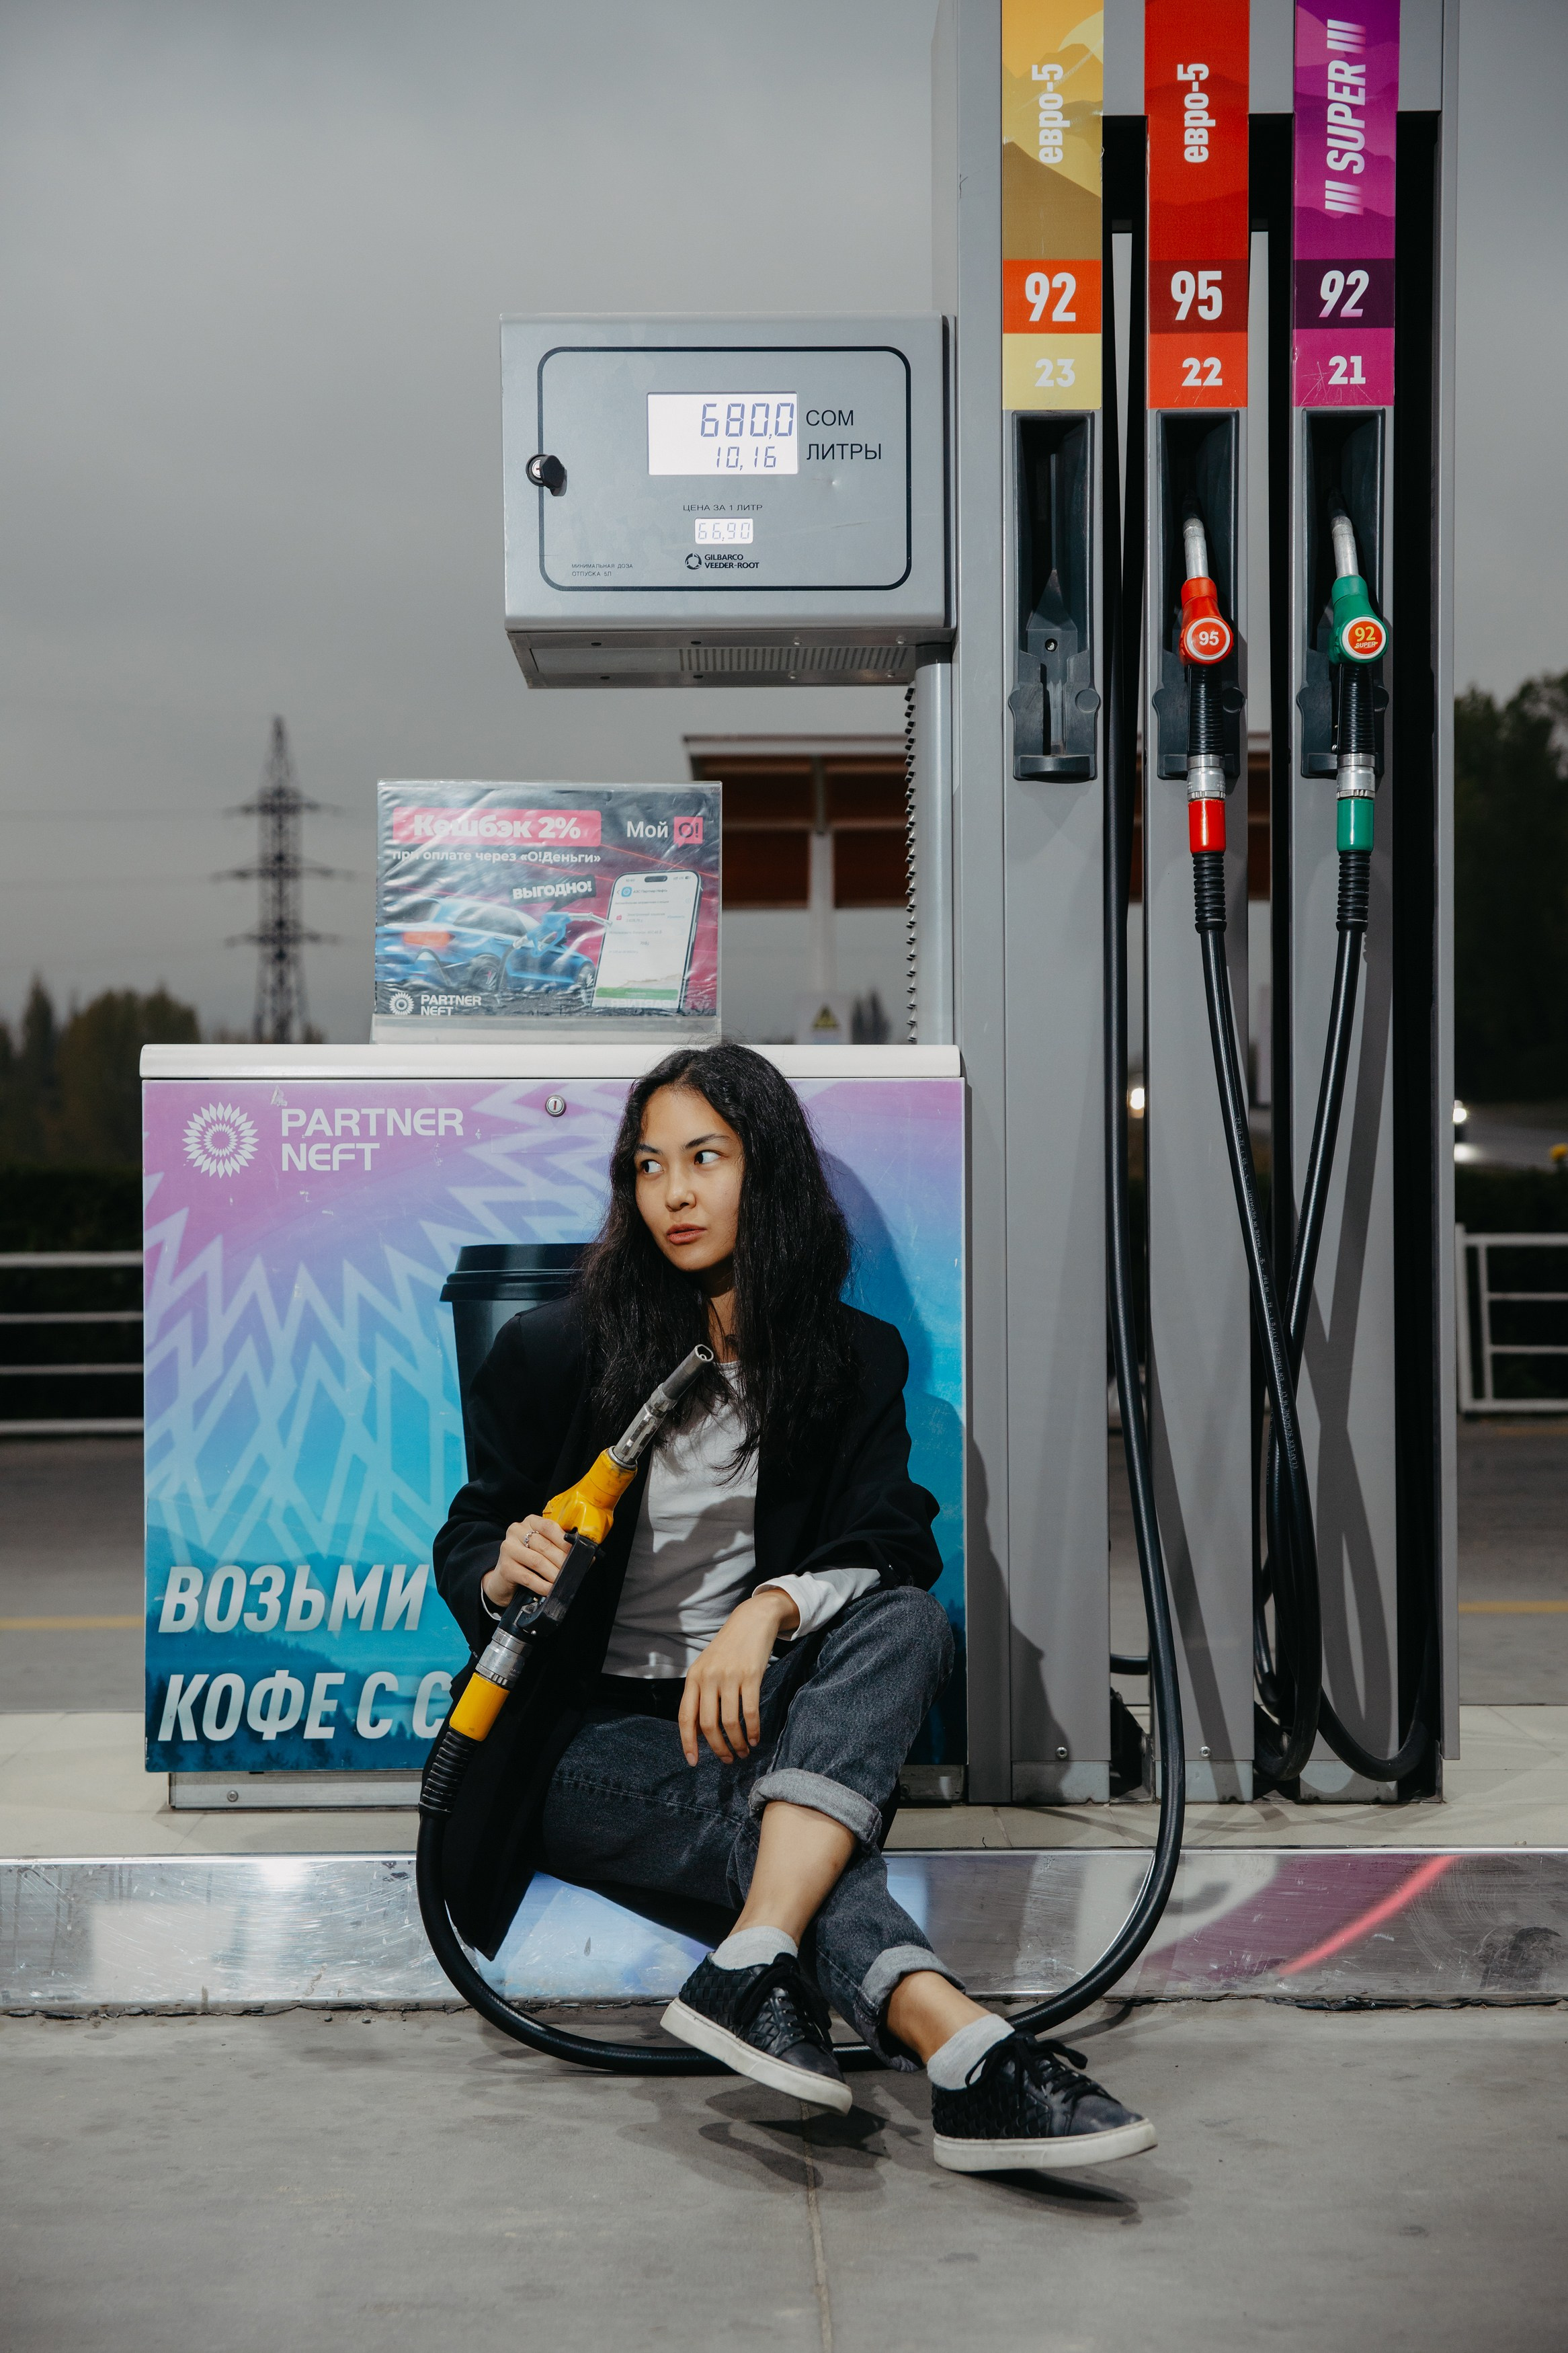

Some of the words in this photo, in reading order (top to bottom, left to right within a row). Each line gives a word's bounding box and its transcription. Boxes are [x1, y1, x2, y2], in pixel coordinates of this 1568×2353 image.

[1032, 63, 1071, 164] евро-5
[1177, 63, 1216, 163] евро-5
[1325, 60, 1366, 174] SUPER
[1025, 272, 1076, 322] 92
[1171, 270, 1223, 321] 95
[1319, 270, 1370, 318] 92
[1035, 358, 1075, 387] 23
[1182, 357, 1223, 387] 22
[1327, 355, 1366, 385] 21
[806, 409, 854, 427] СОМ
[806, 443, 882, 461] ЛИТРЫ
[1198, 631, 1219, 646] 95
[1354, 626, 1376, 642] 92
[538, 816, 581, 839] 2%
[626, 821, 668, 838] Мой
[423, 851, 472, 861] оплате
[475, 852, 516, 863] через
[421, 994, 482, 1006] PARTNER
[421, 1005, 454, 1016] NEFT
[281, 1107, 464, 1137] PARTNER
[281, 1143, 380, 1171] NEFT
[1247, 1189, 1257, 1219] GERMANY
[1289, 1439, 1298, 1469] ELAFLEX
[158, 1564, 429, 1633] ВОЗЬМИ
[157, 1670, 346, 1741] КОФЕ
[356, 1671, 399, 1739] С
